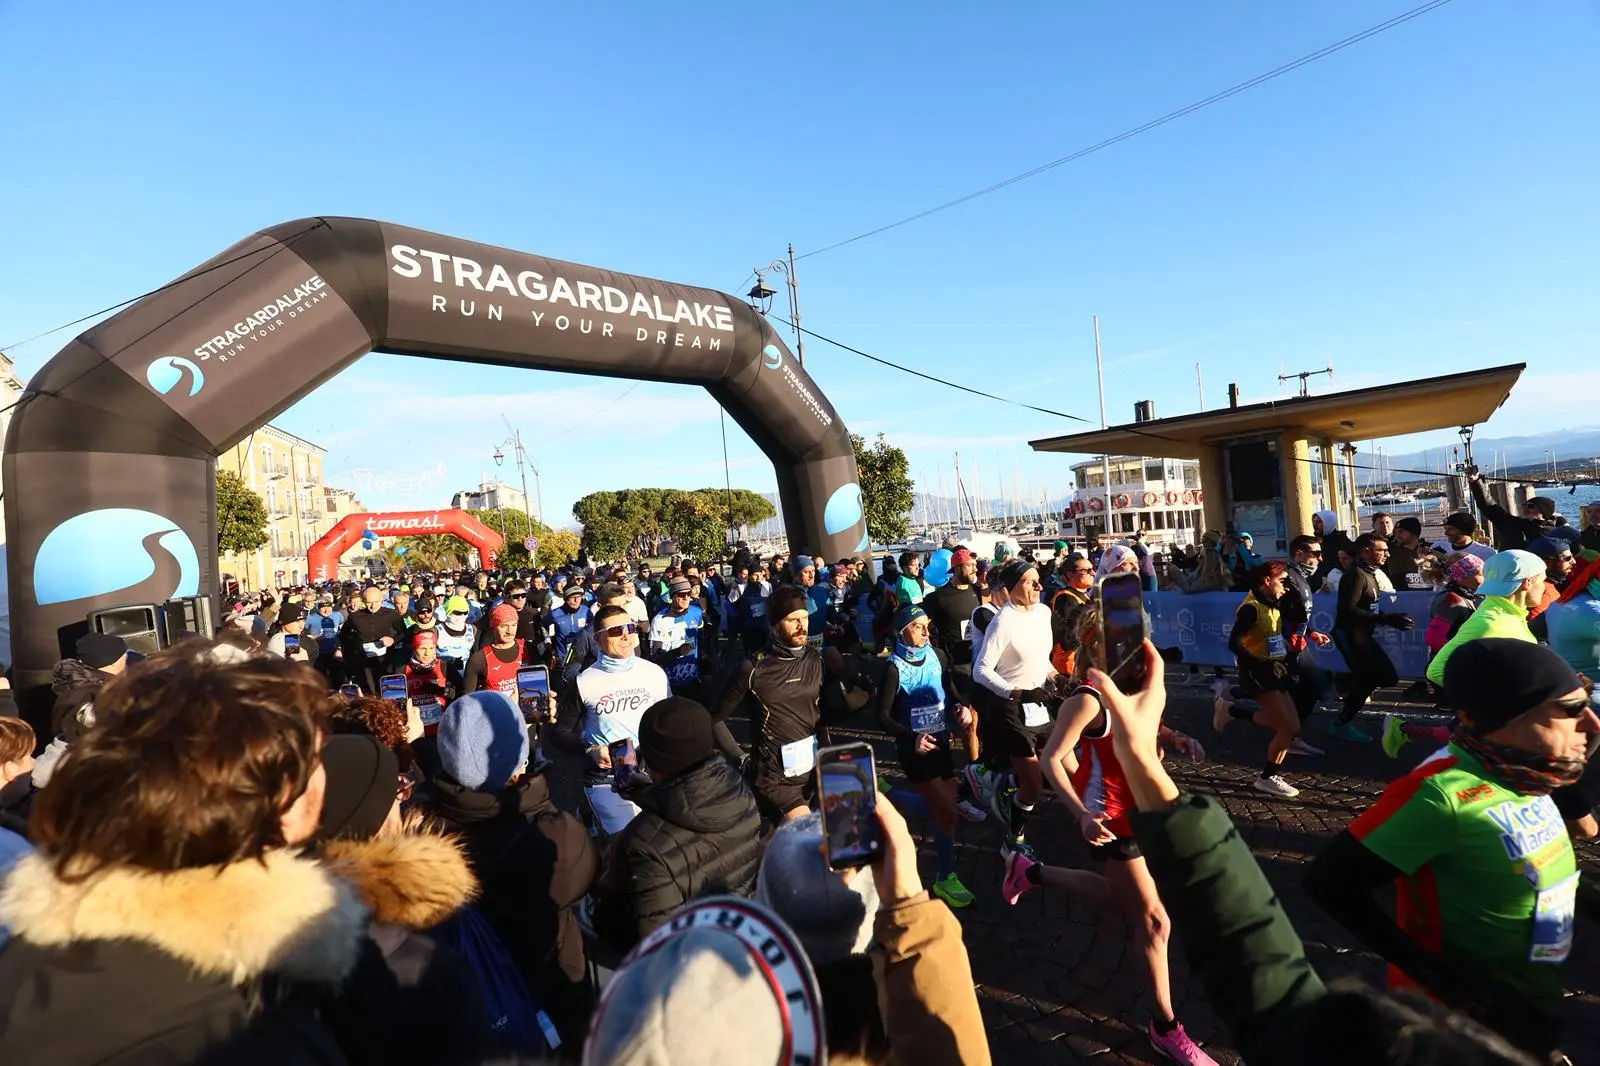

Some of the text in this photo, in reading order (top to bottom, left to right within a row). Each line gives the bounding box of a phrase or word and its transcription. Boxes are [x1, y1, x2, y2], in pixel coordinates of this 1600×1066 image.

[194, 275, 326, 361] STRAGARDALAKE
[390, 244, 734, 332] STRAGARDALAKE
[219, 291, 328, 363] RUN YOUR DREAM
[432, 294, 722, 351] RUN YOUR DREAM
[782, 364, 832, 425] STRAGARDALAKE
[365, 514, 445, 530] tomasi
